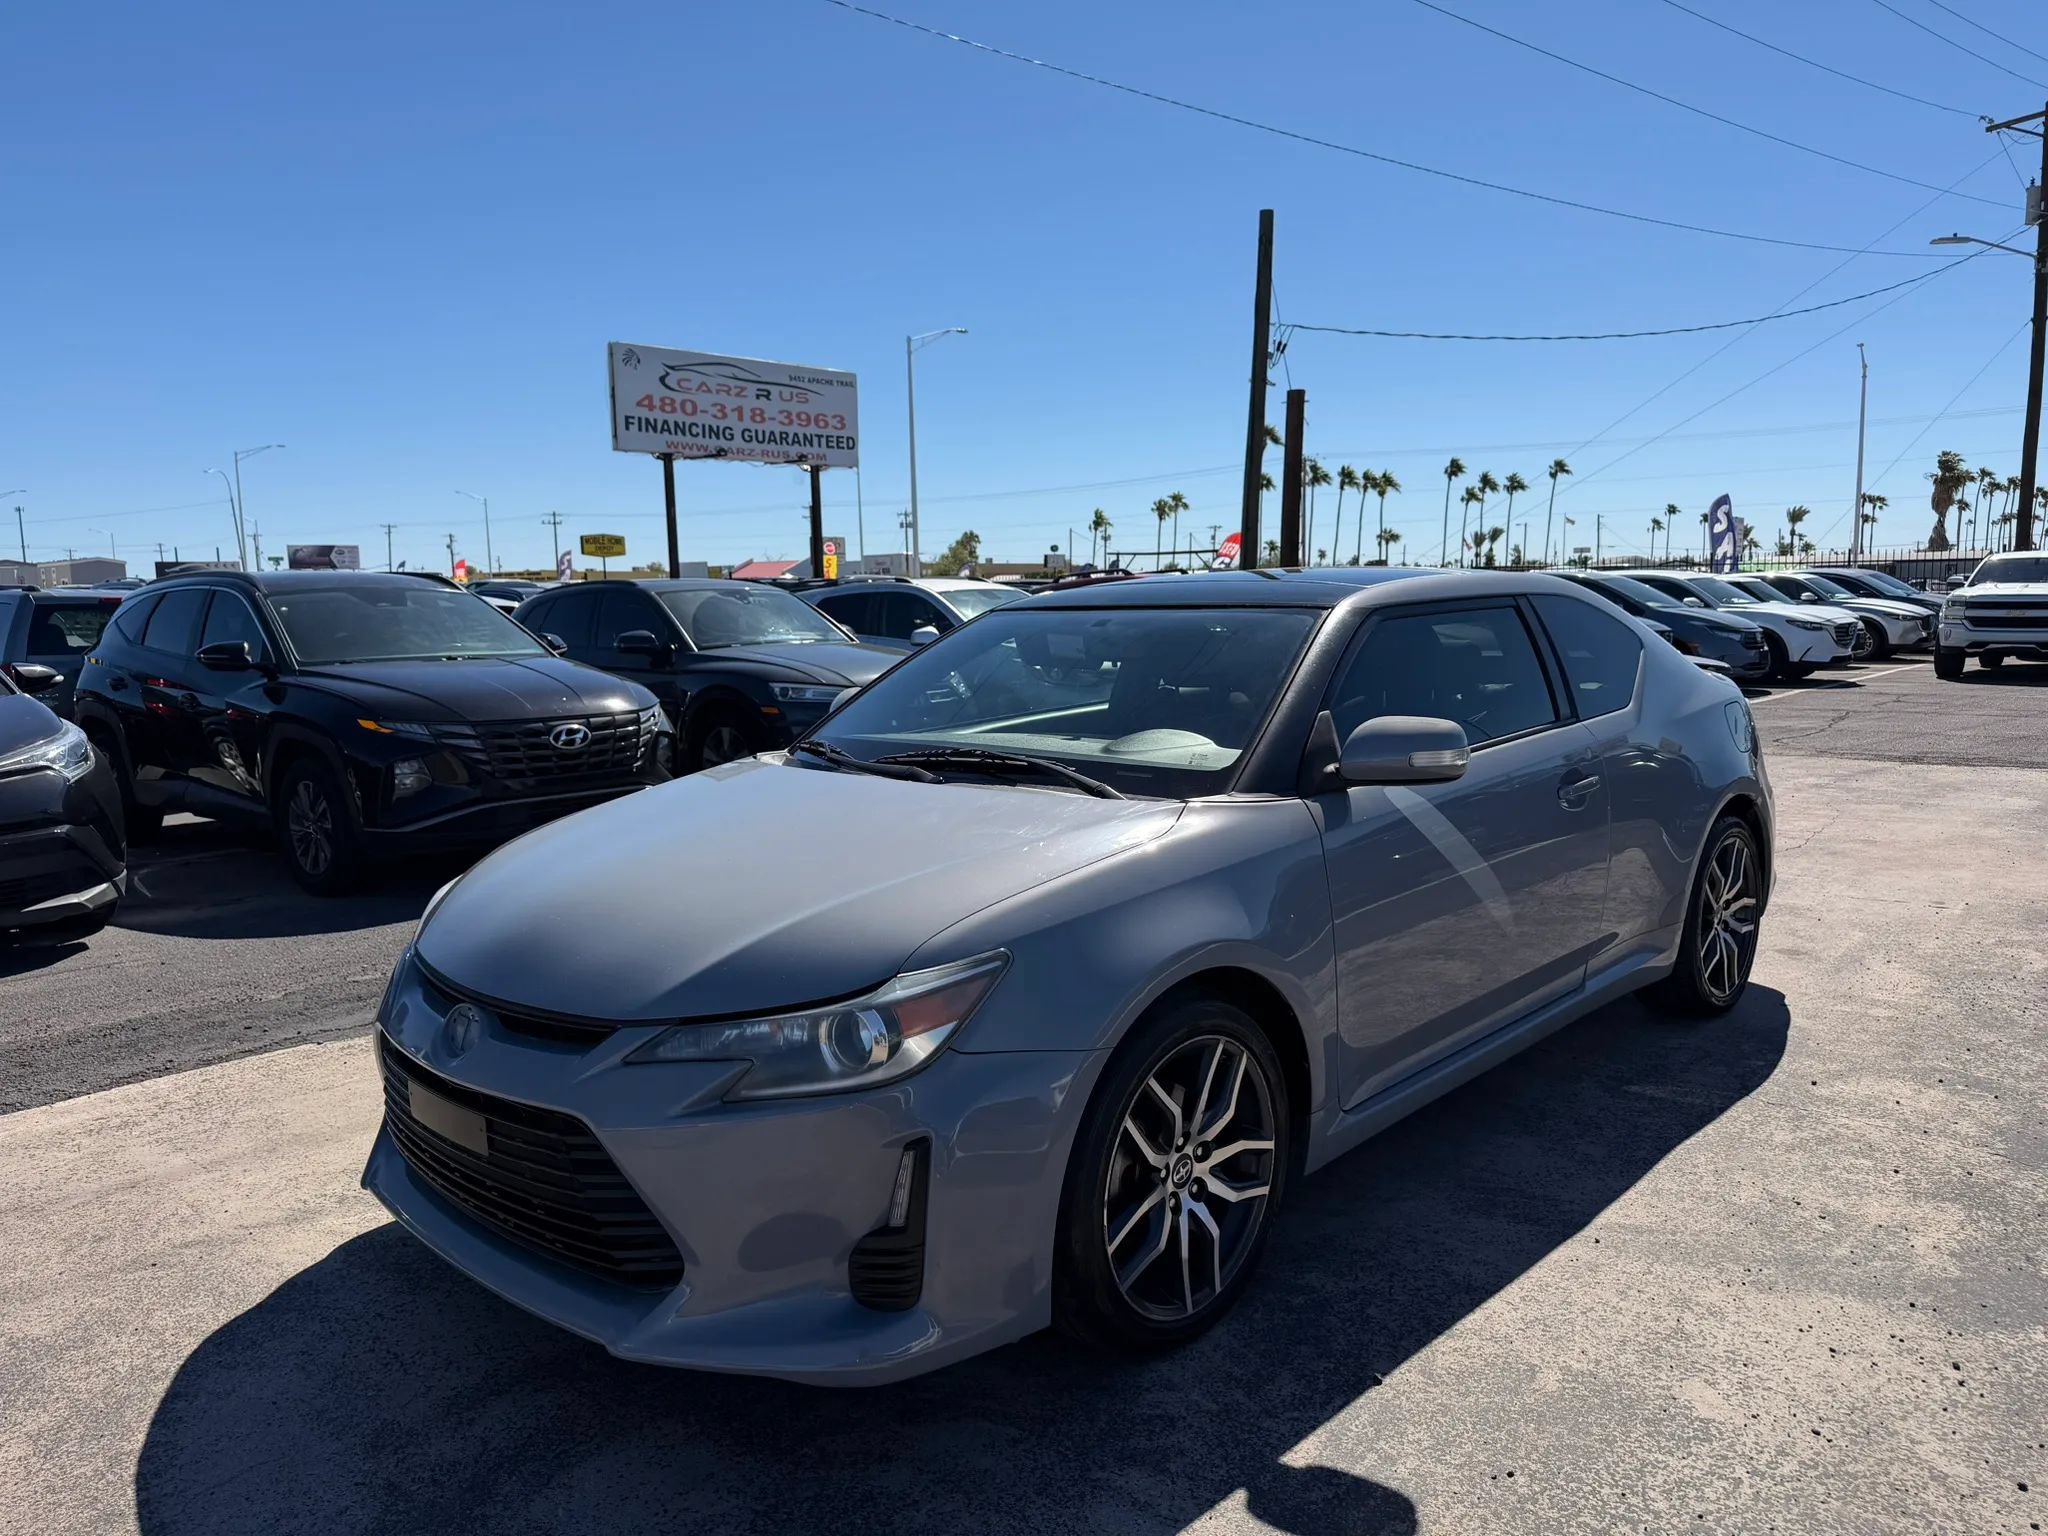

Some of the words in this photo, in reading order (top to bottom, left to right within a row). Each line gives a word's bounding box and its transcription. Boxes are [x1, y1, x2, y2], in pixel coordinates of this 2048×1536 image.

[676, 377, 749, 399] CARZ
[755, 388, 772, 401] R
[779, 390, 809, 404] US
[807, 376, 834, 386] APACHE
[836, 379, 855, 388] TRAIL
[635, 393, 847, 431] 480-318-3963
[624, 415, 735, 442] FINANCING
[741, 428, 856, 450] GUARANTEED
